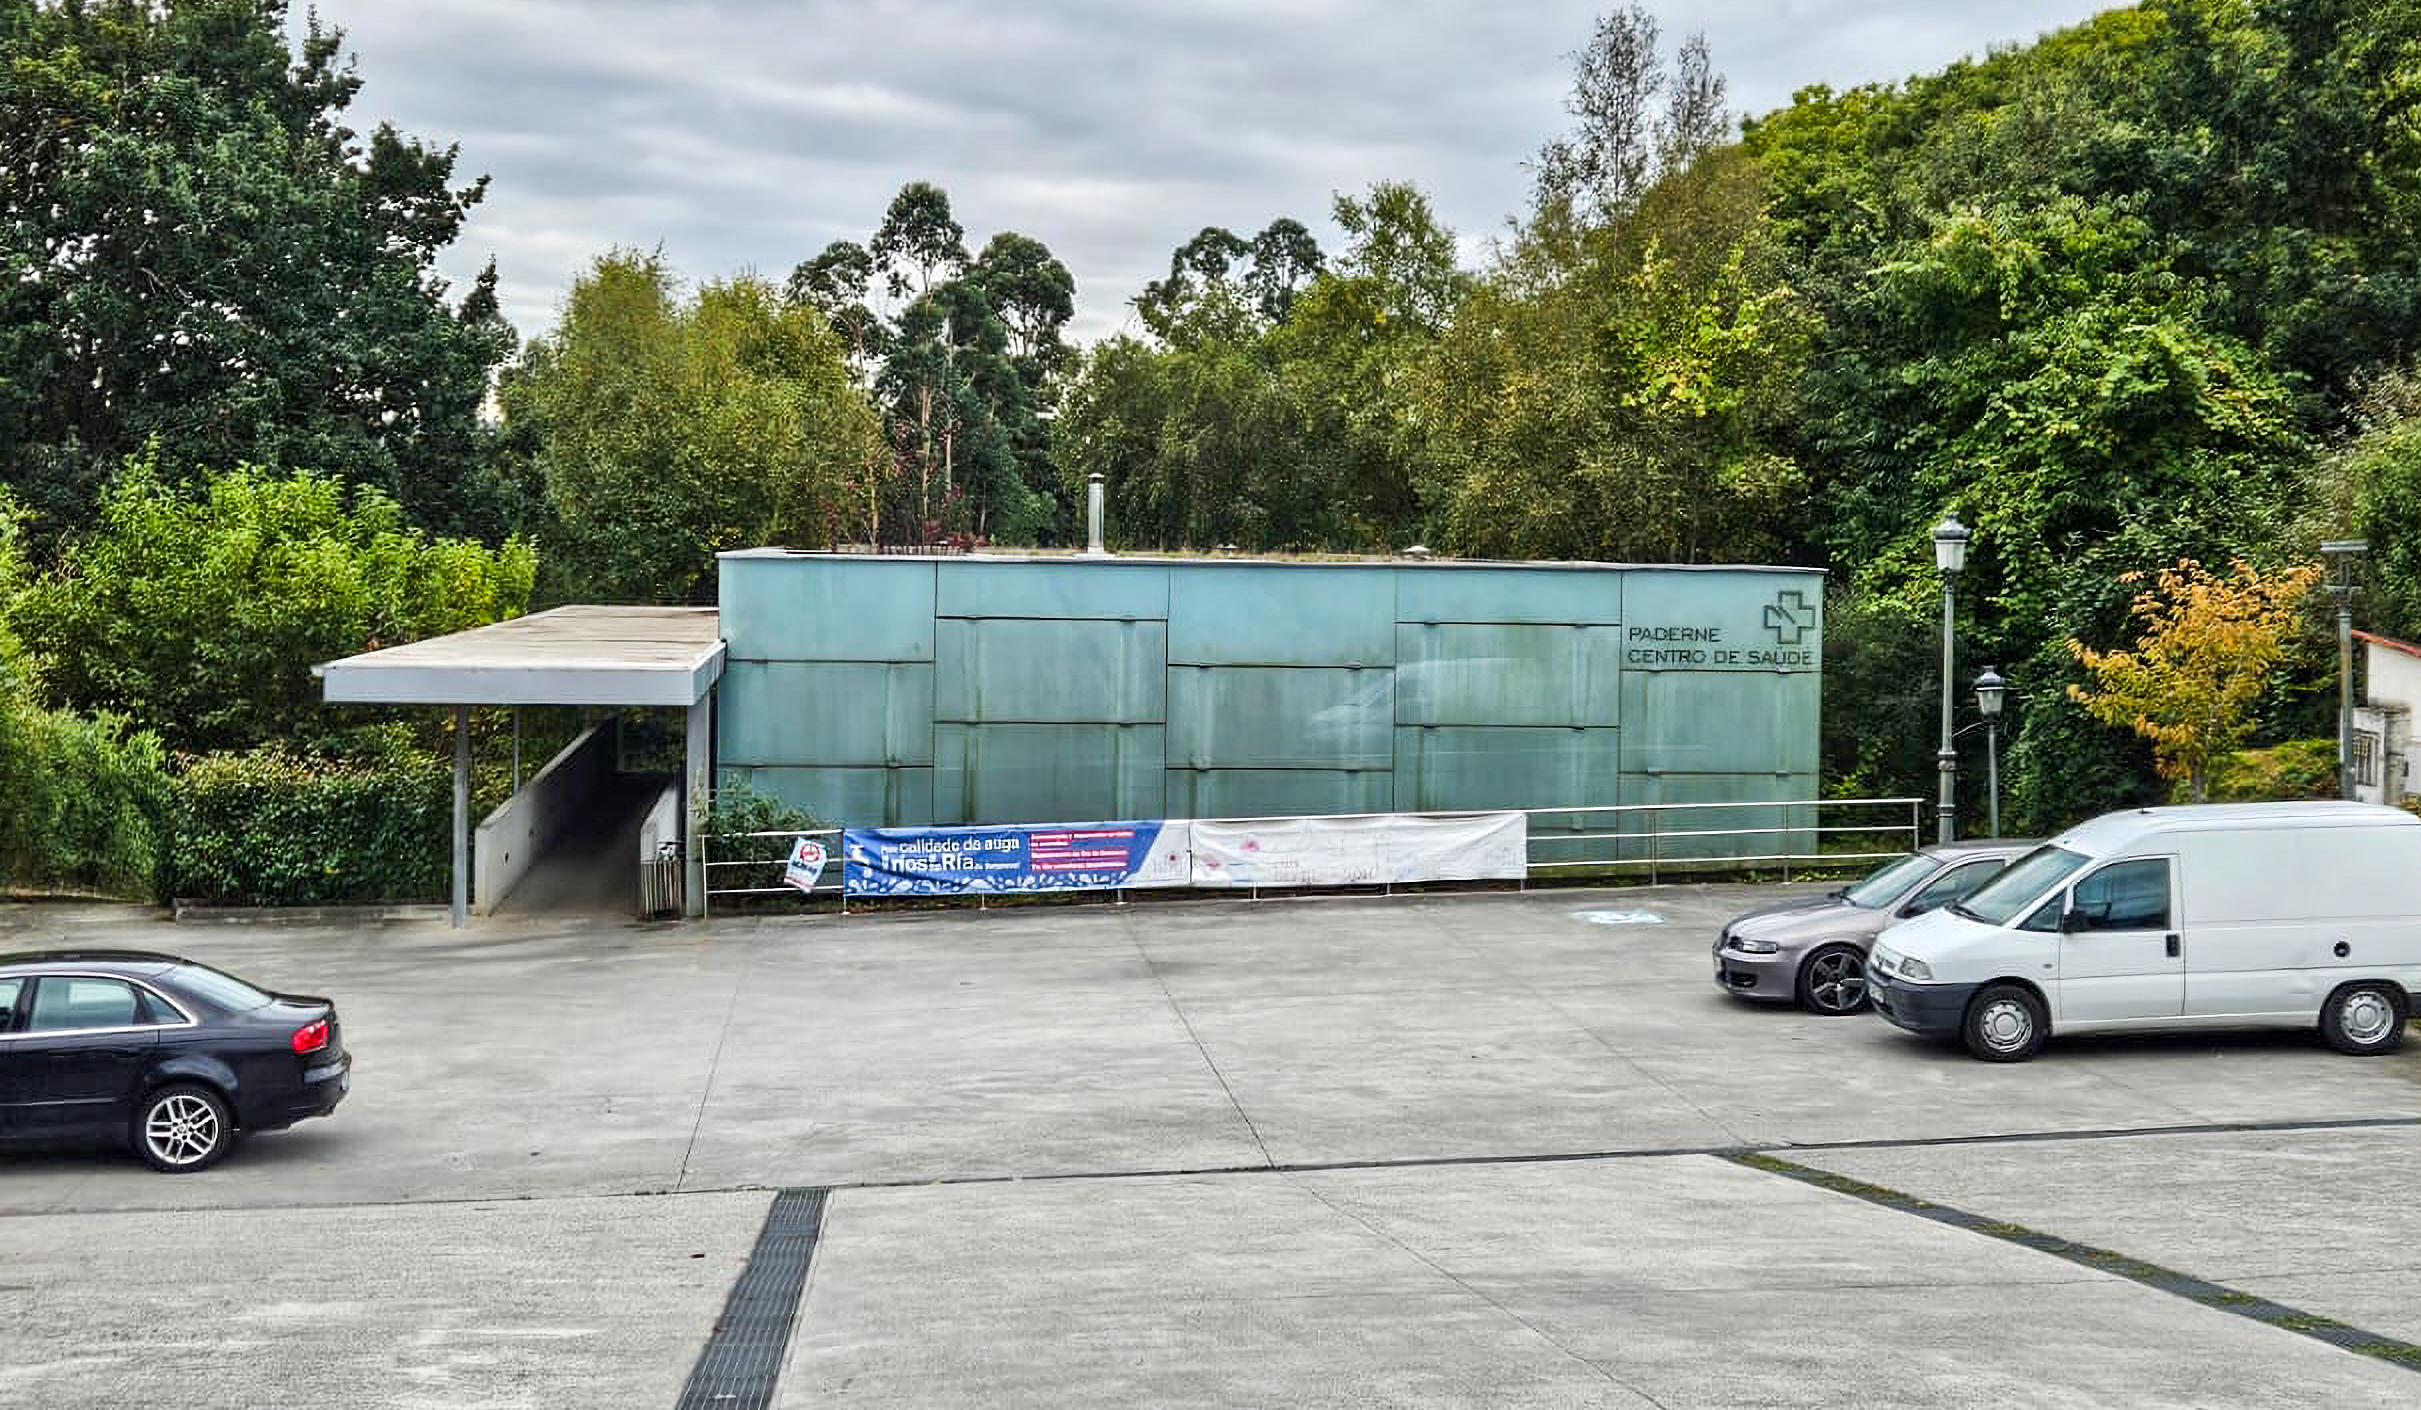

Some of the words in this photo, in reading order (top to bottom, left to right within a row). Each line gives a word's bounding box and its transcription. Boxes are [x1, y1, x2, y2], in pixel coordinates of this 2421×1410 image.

[1629, 627, 1722, 642] PADERNE
[1629, 650, 1706, 664] CENTRO
[1714, 651, 1740, 664] DE
